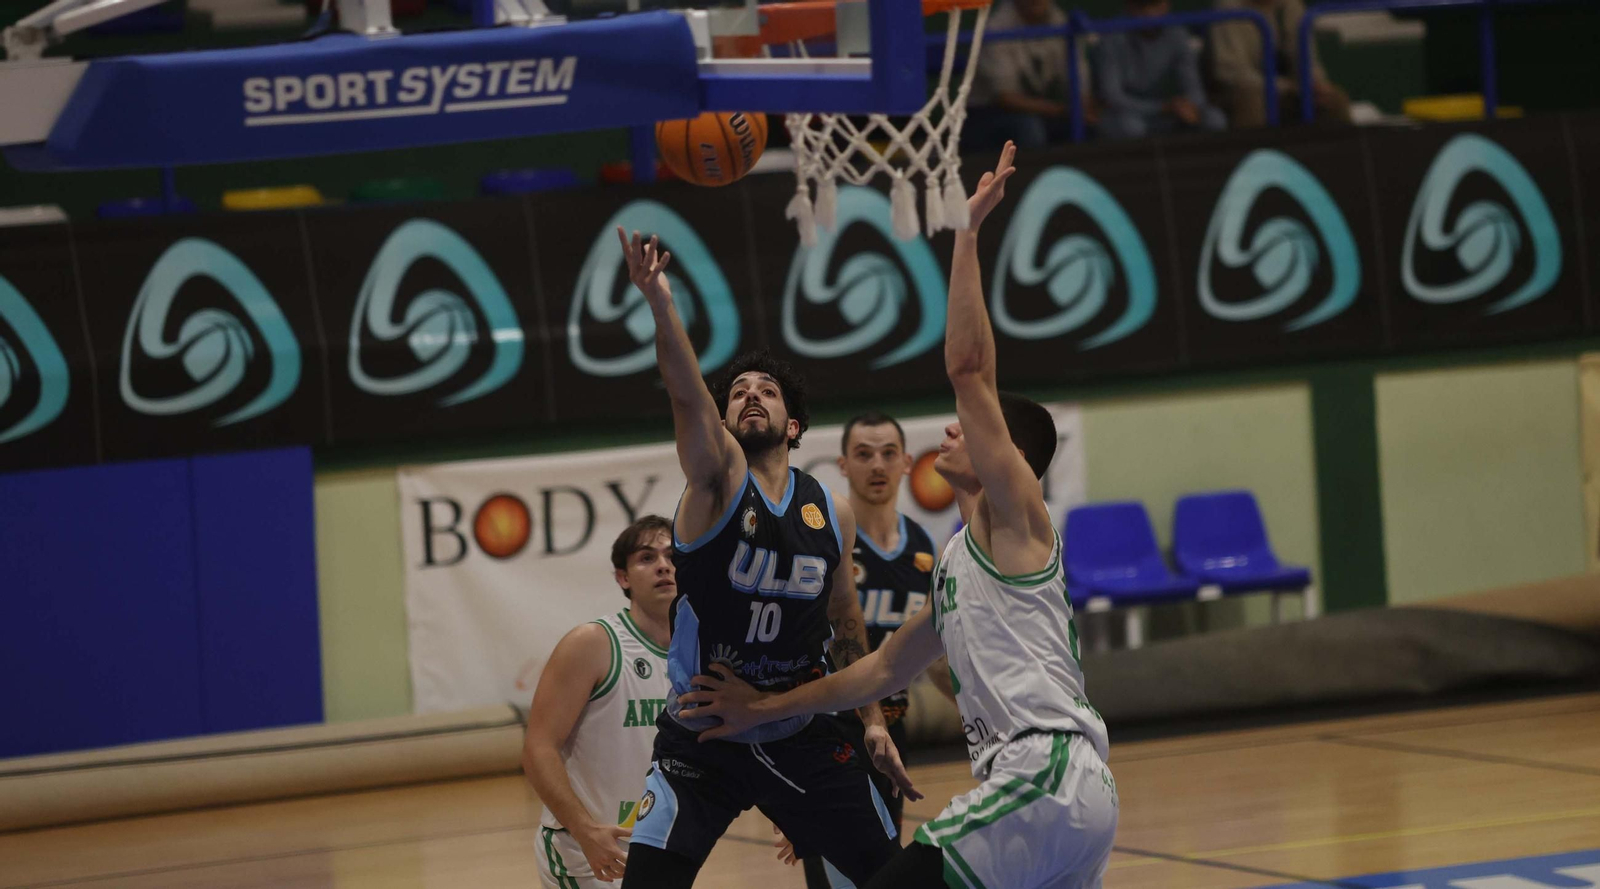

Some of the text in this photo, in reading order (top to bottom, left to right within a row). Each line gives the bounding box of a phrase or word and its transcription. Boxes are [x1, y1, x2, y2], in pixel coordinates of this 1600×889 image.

[243, 57, 579, 113] SPORT SYSTEM
[416, 474, 660, 569] BODY
[727, 539, 828, 600] ULB
[744, 601, 783, 643] 10
